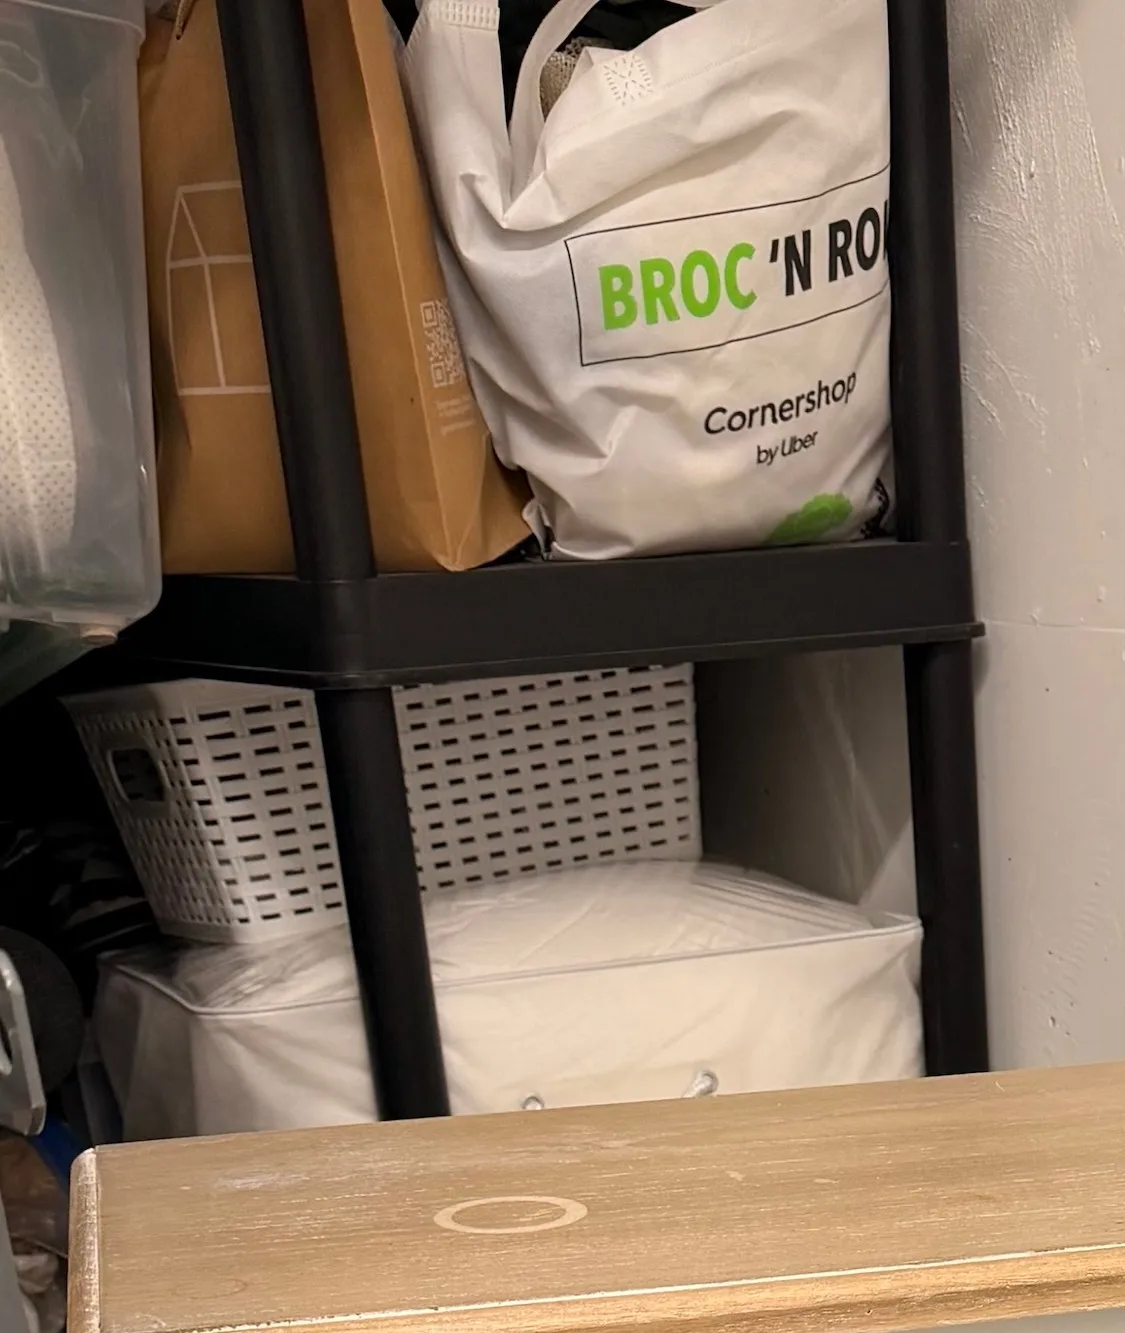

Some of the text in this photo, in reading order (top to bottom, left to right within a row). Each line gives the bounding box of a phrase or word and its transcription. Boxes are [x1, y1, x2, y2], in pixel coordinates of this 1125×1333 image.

[598, 242, 757, 331] BROC
[828, 199, 888, 283] RO
[704, 372, 856, 434] Cornershop
[756, 431, 818, 466] by Uber
